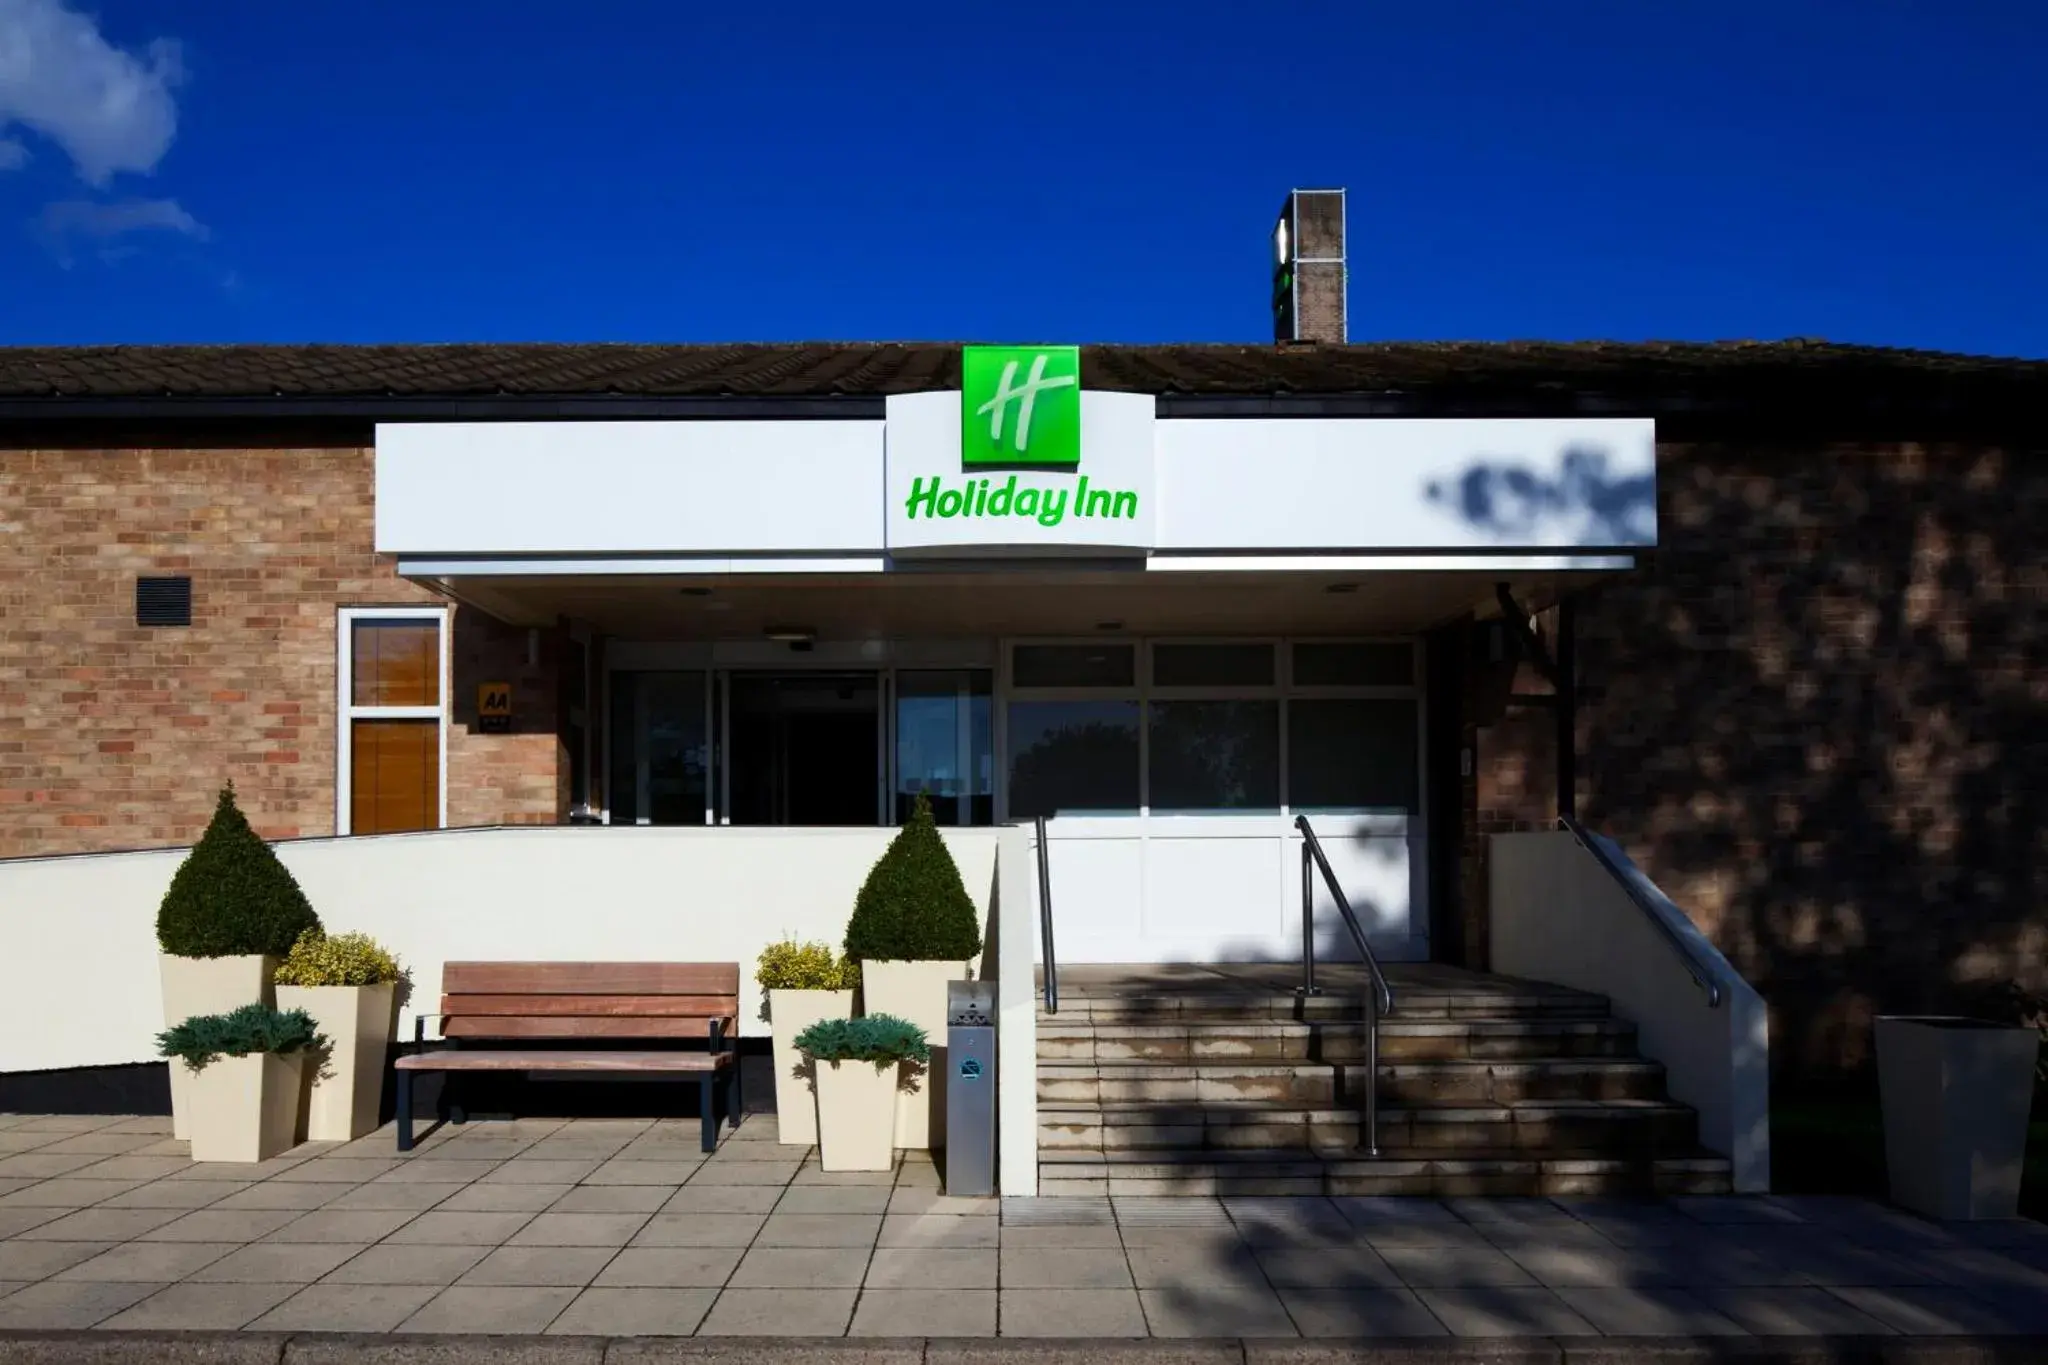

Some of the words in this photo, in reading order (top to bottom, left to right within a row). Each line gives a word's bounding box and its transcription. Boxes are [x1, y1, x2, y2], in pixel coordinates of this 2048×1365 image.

[977, 355, 1075, 451] H
[906, 476, 1068, 526] Holiday
[1074, 476, 1137, 519] Inn
[484, 691, 508, 710] AA
